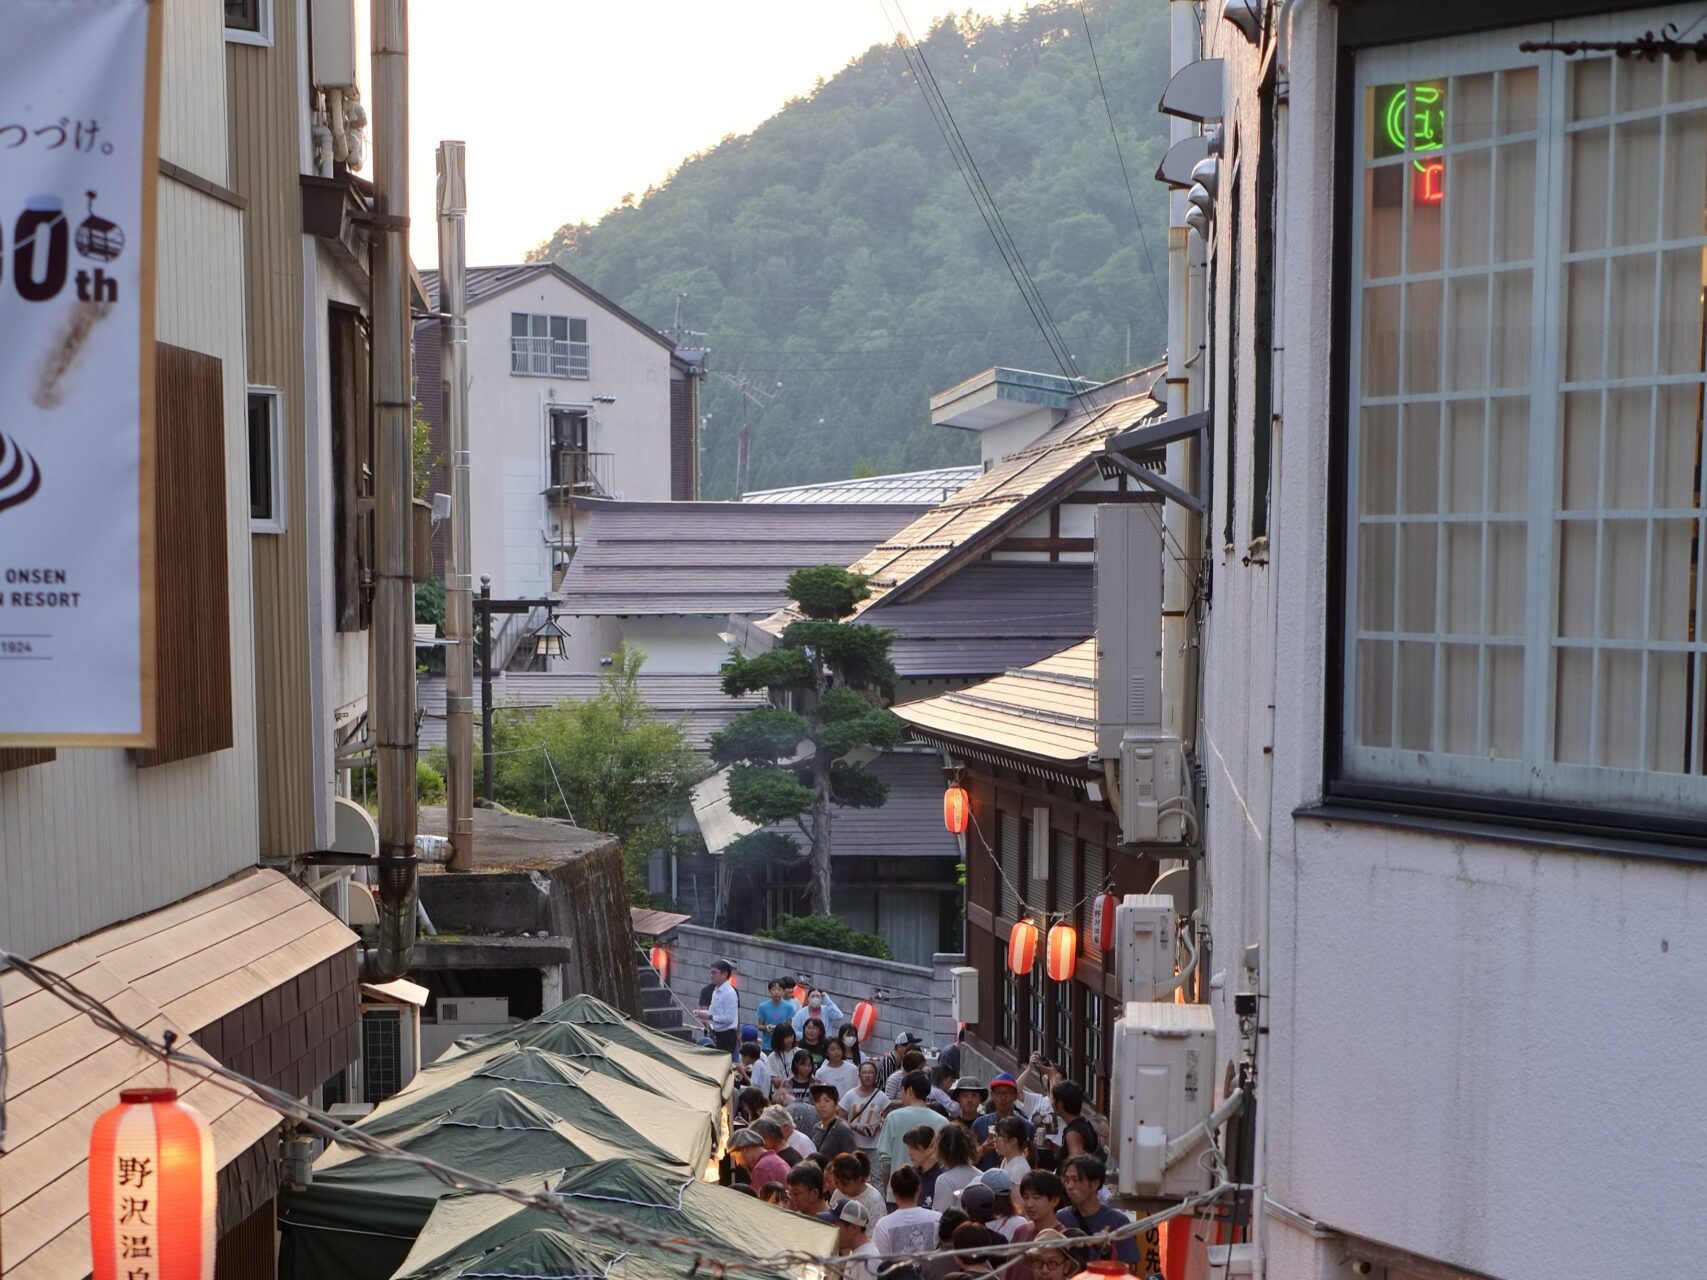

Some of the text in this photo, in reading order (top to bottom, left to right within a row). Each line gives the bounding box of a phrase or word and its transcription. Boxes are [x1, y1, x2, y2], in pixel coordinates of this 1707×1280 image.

[5, 568, 67, 584] ONSEN
[11, 591, 81, 607] RESORT
[1145, 1211, 1161, 1273] の先
